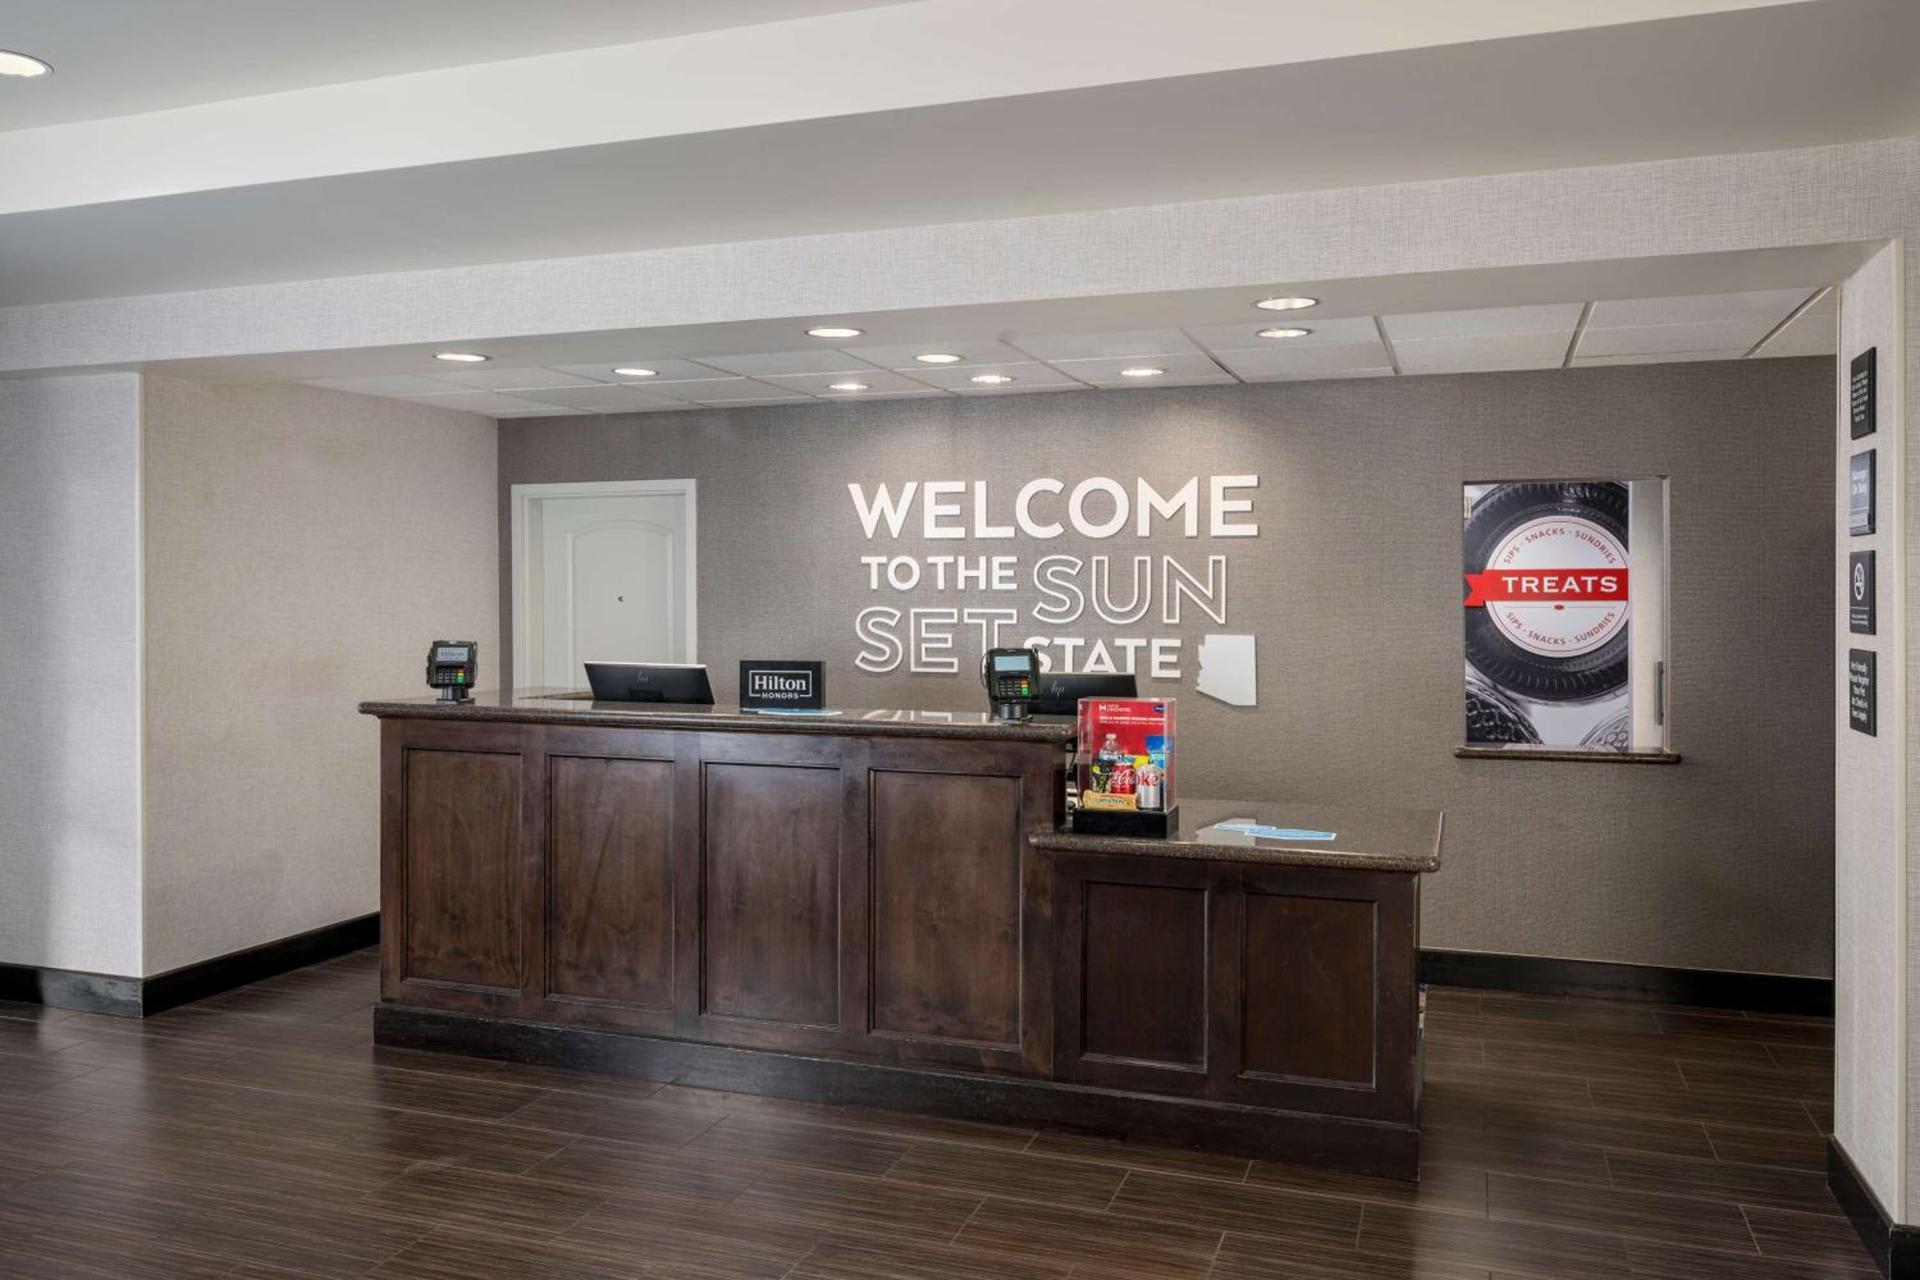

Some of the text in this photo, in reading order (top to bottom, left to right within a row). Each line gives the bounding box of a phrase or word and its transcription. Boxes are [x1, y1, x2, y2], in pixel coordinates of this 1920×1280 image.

[848, 475, 1259, 539] WELCOME
[1504, 528, 1616, 564] SIPS SNACKS SUNDRIES
[861, 555, 1226, 625] TO THE SUN
[1502, 576, 1618, 593] TREATS
[855, 606, 1182, 678] SET STATE
[1507, 612, 1615, 645] SIPS SNACKS SUNDRIES
[754, 676, 806, 691] Hilton
[762, 692, 799, 700] HONORS
